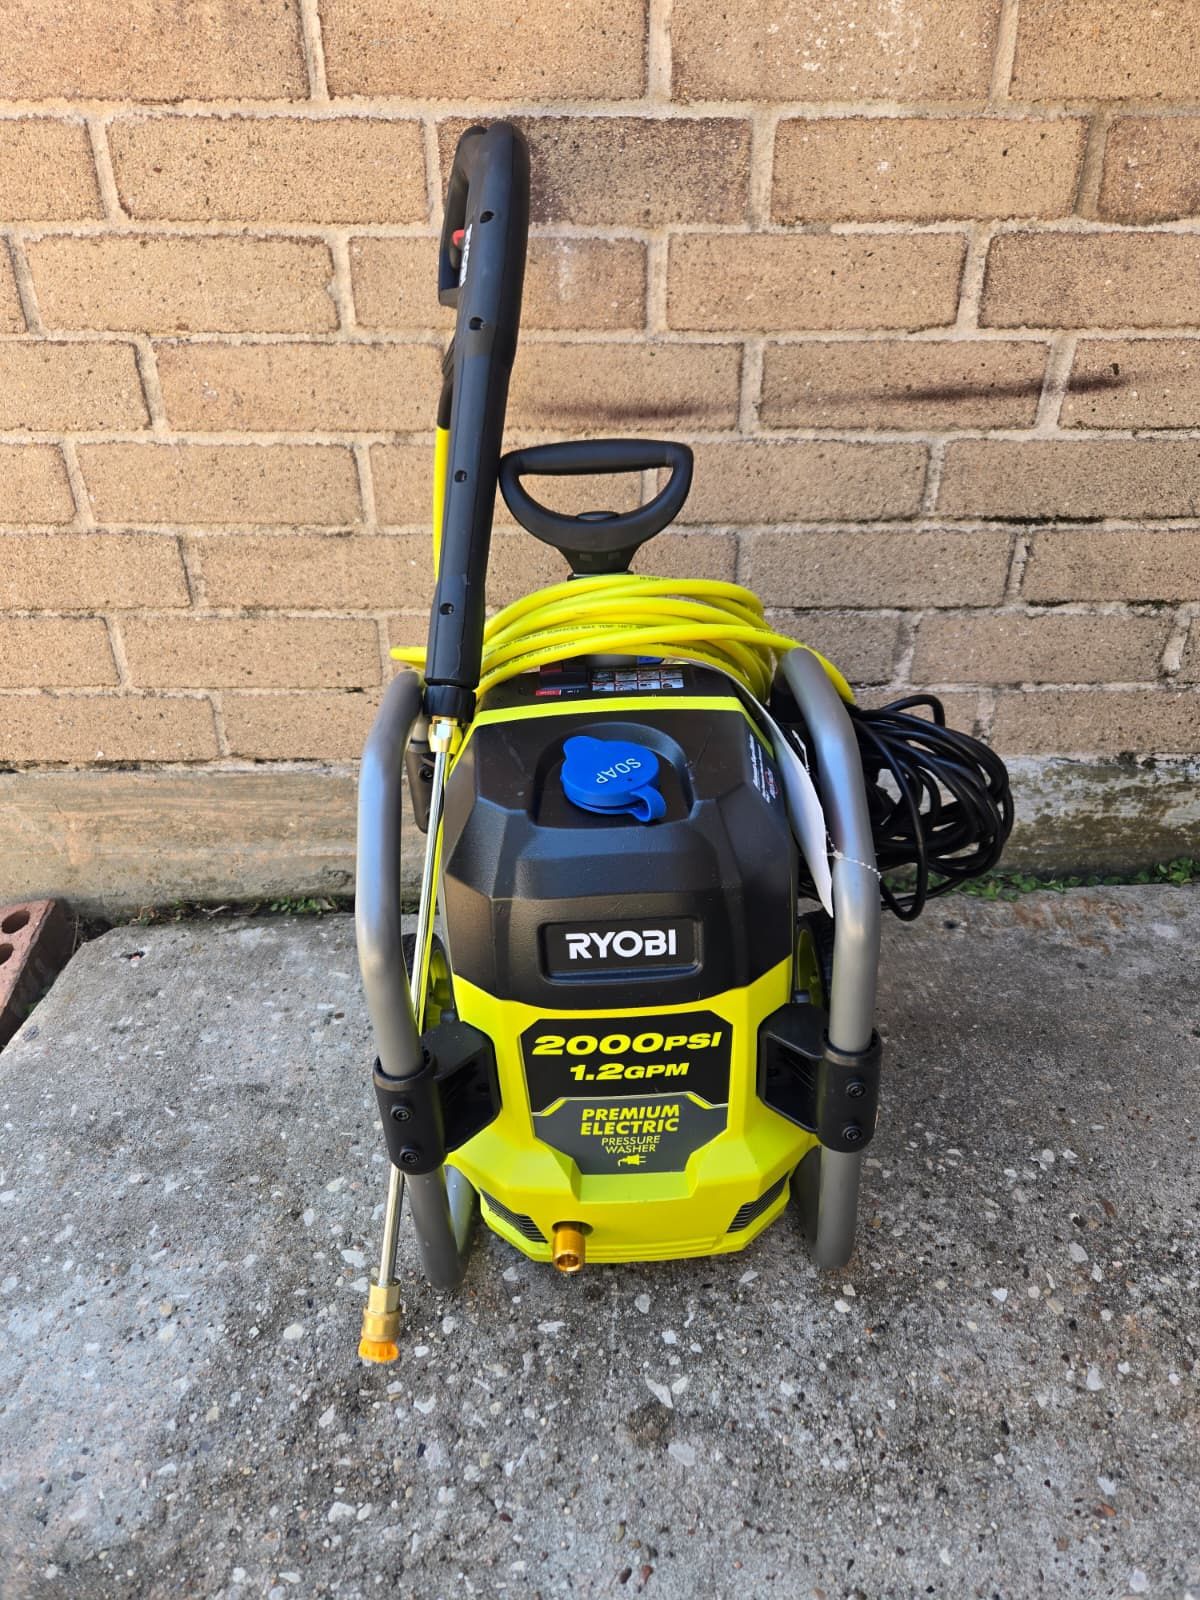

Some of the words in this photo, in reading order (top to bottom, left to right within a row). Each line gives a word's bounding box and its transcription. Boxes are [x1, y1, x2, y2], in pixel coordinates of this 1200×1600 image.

[596, 758, 641, 784] SOAP
[565, 928, 677, 959] RYOBI
[532, 1031, 722, 1056] 2000PSI
[570, 1062, 690, 1081] 1.2GPM
[582, 1104, 680, 1121] PREMIUM
[580, 1118, 680, 1135] ELECTRIC
[601, 1135, 661, 1146] PRESSURE
[605, 1144, 656, 1154] WASHER
